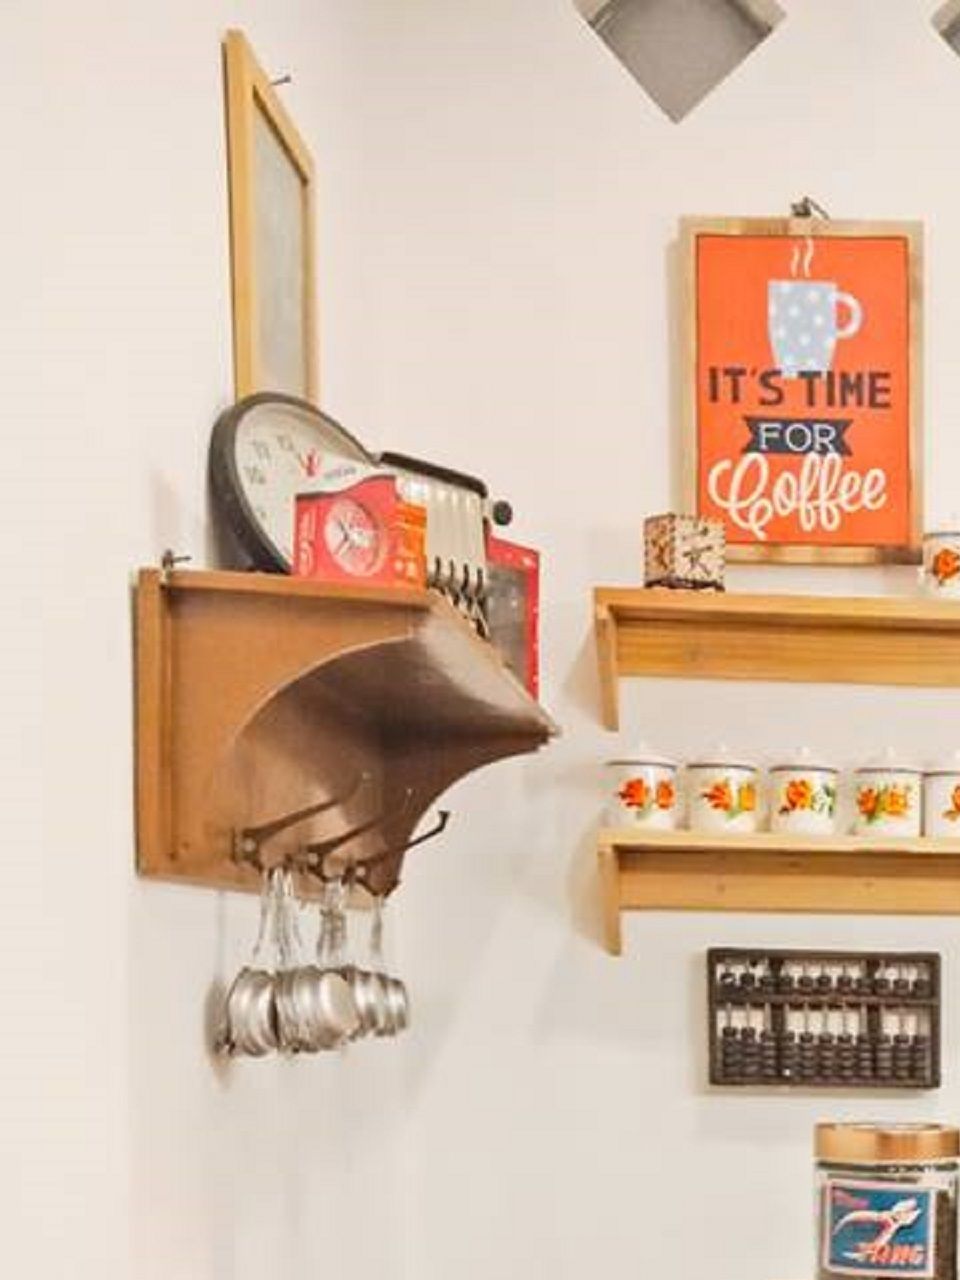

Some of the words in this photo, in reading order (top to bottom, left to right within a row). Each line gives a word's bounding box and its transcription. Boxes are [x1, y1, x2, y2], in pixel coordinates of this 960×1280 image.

[708, 367, 785, 406] IT'S
[796, 370, 892, 409] TIME
[758, 422, 838, 452] FOR
[707, 451, 888, 541] Coffee
